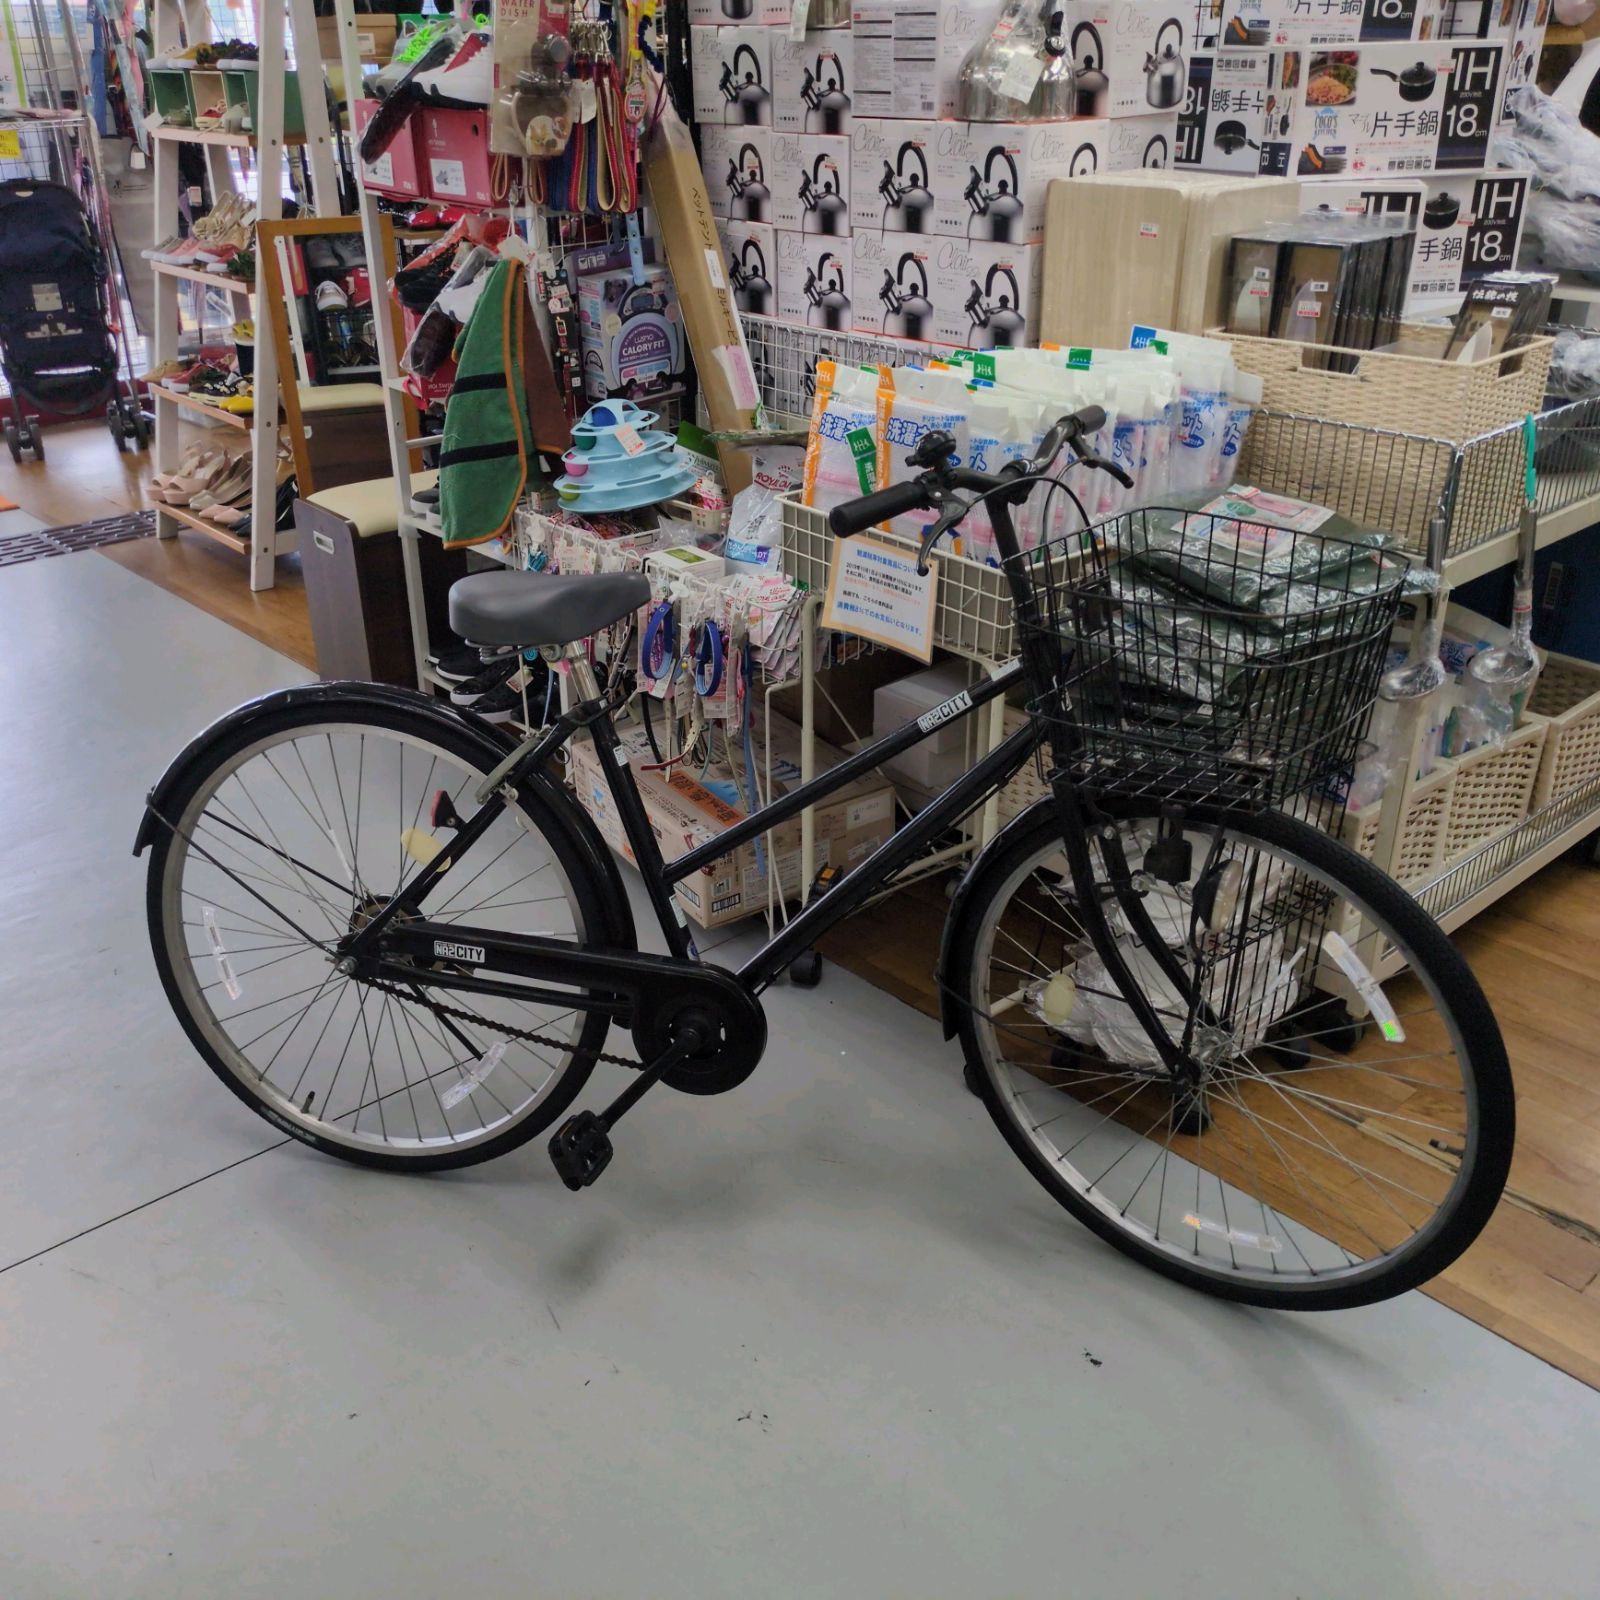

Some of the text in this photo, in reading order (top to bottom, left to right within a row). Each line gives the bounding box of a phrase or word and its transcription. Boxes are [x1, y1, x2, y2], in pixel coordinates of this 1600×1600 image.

[501, 8, 528, 16] DISH
[1453, 51, 1496, 91] IH
[1477, 182, 1519, 219] IH
[622, 340, 666, 356] CALORY FIT
